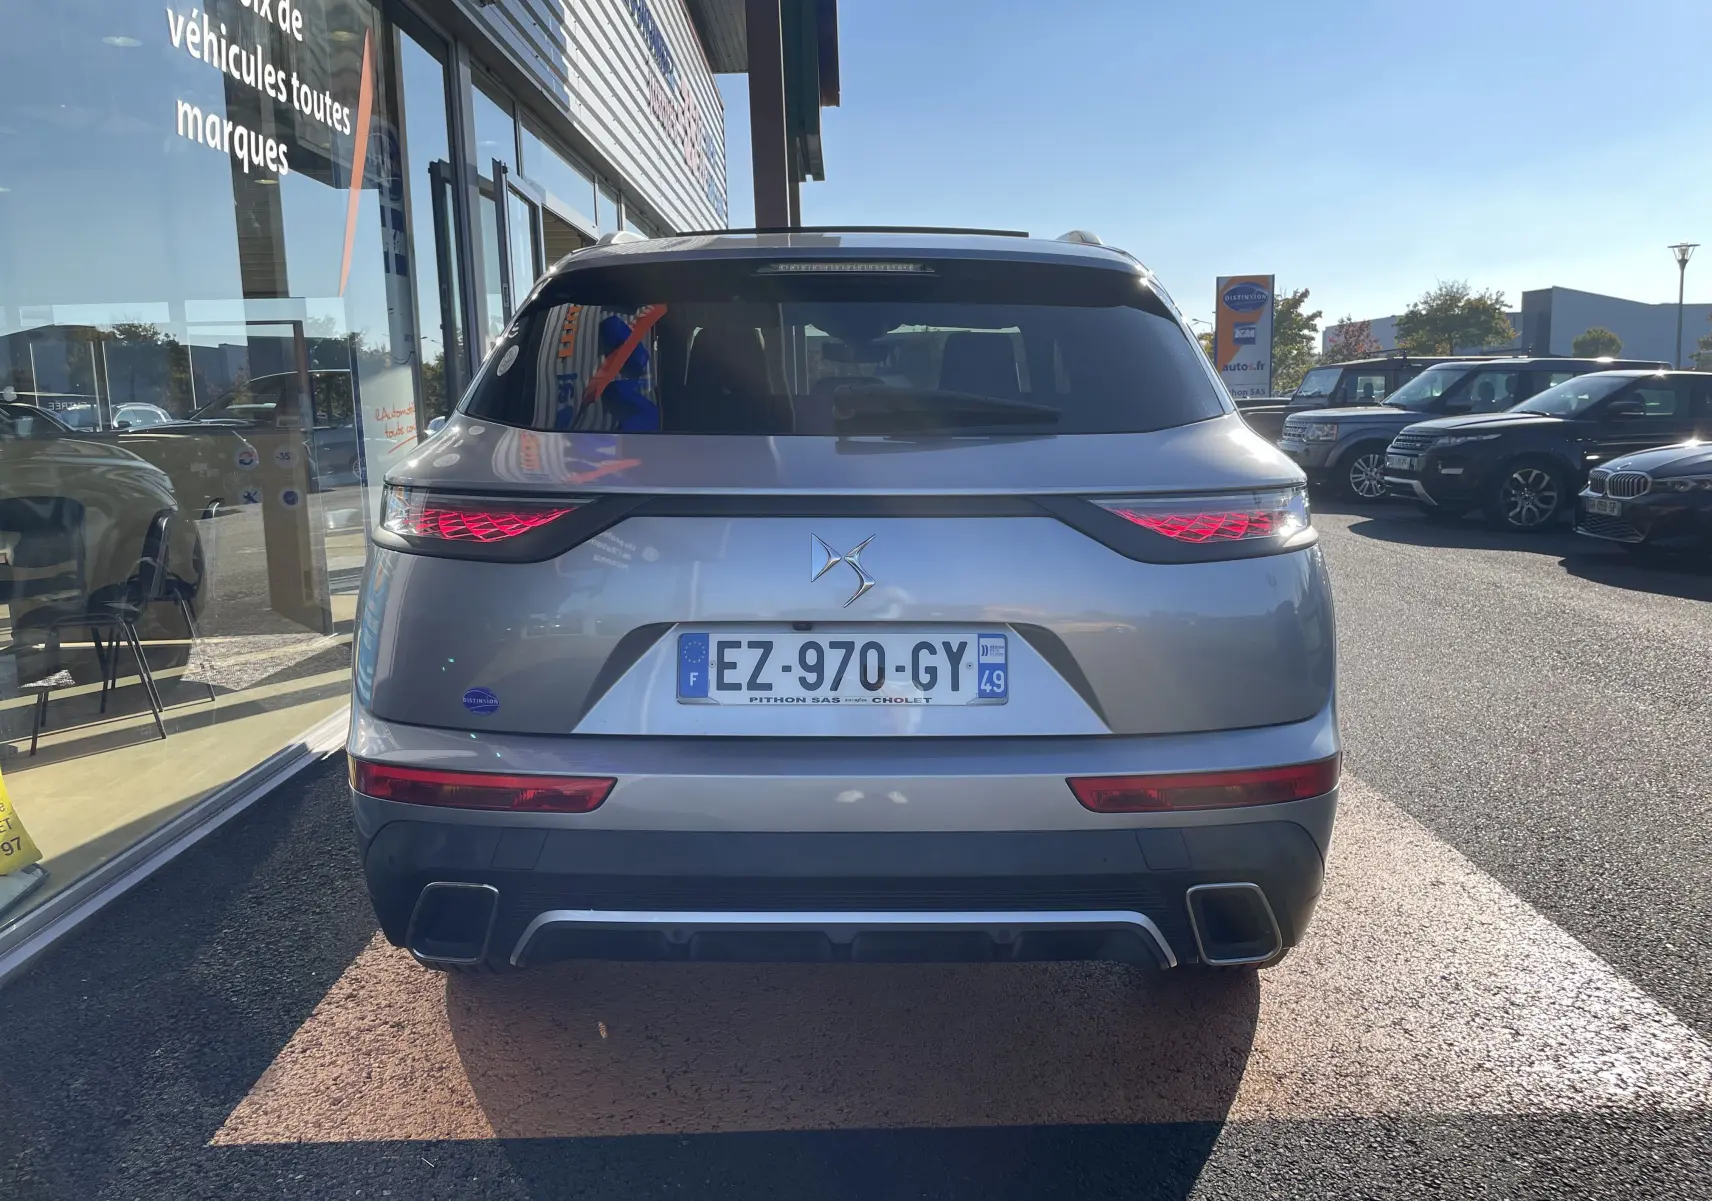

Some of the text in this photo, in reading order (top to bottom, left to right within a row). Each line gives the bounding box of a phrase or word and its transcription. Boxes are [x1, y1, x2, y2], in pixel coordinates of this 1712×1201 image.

[278, 0, 303, 42] de
[166, 8, 351, 136] véhicules toutes
[177, 99, 289, 176] marques
[1223, 360, 1266, 372] autos.fr
[1250, 387, 1266, 397] SAS
[384, 421, 404, 438] toute
[689, 672, 699, 687] F
[716, 640, 968, 692] EZ-970-GY
[980, 669, 1005, 693] 49
[1, 836, 22, 856] 97
